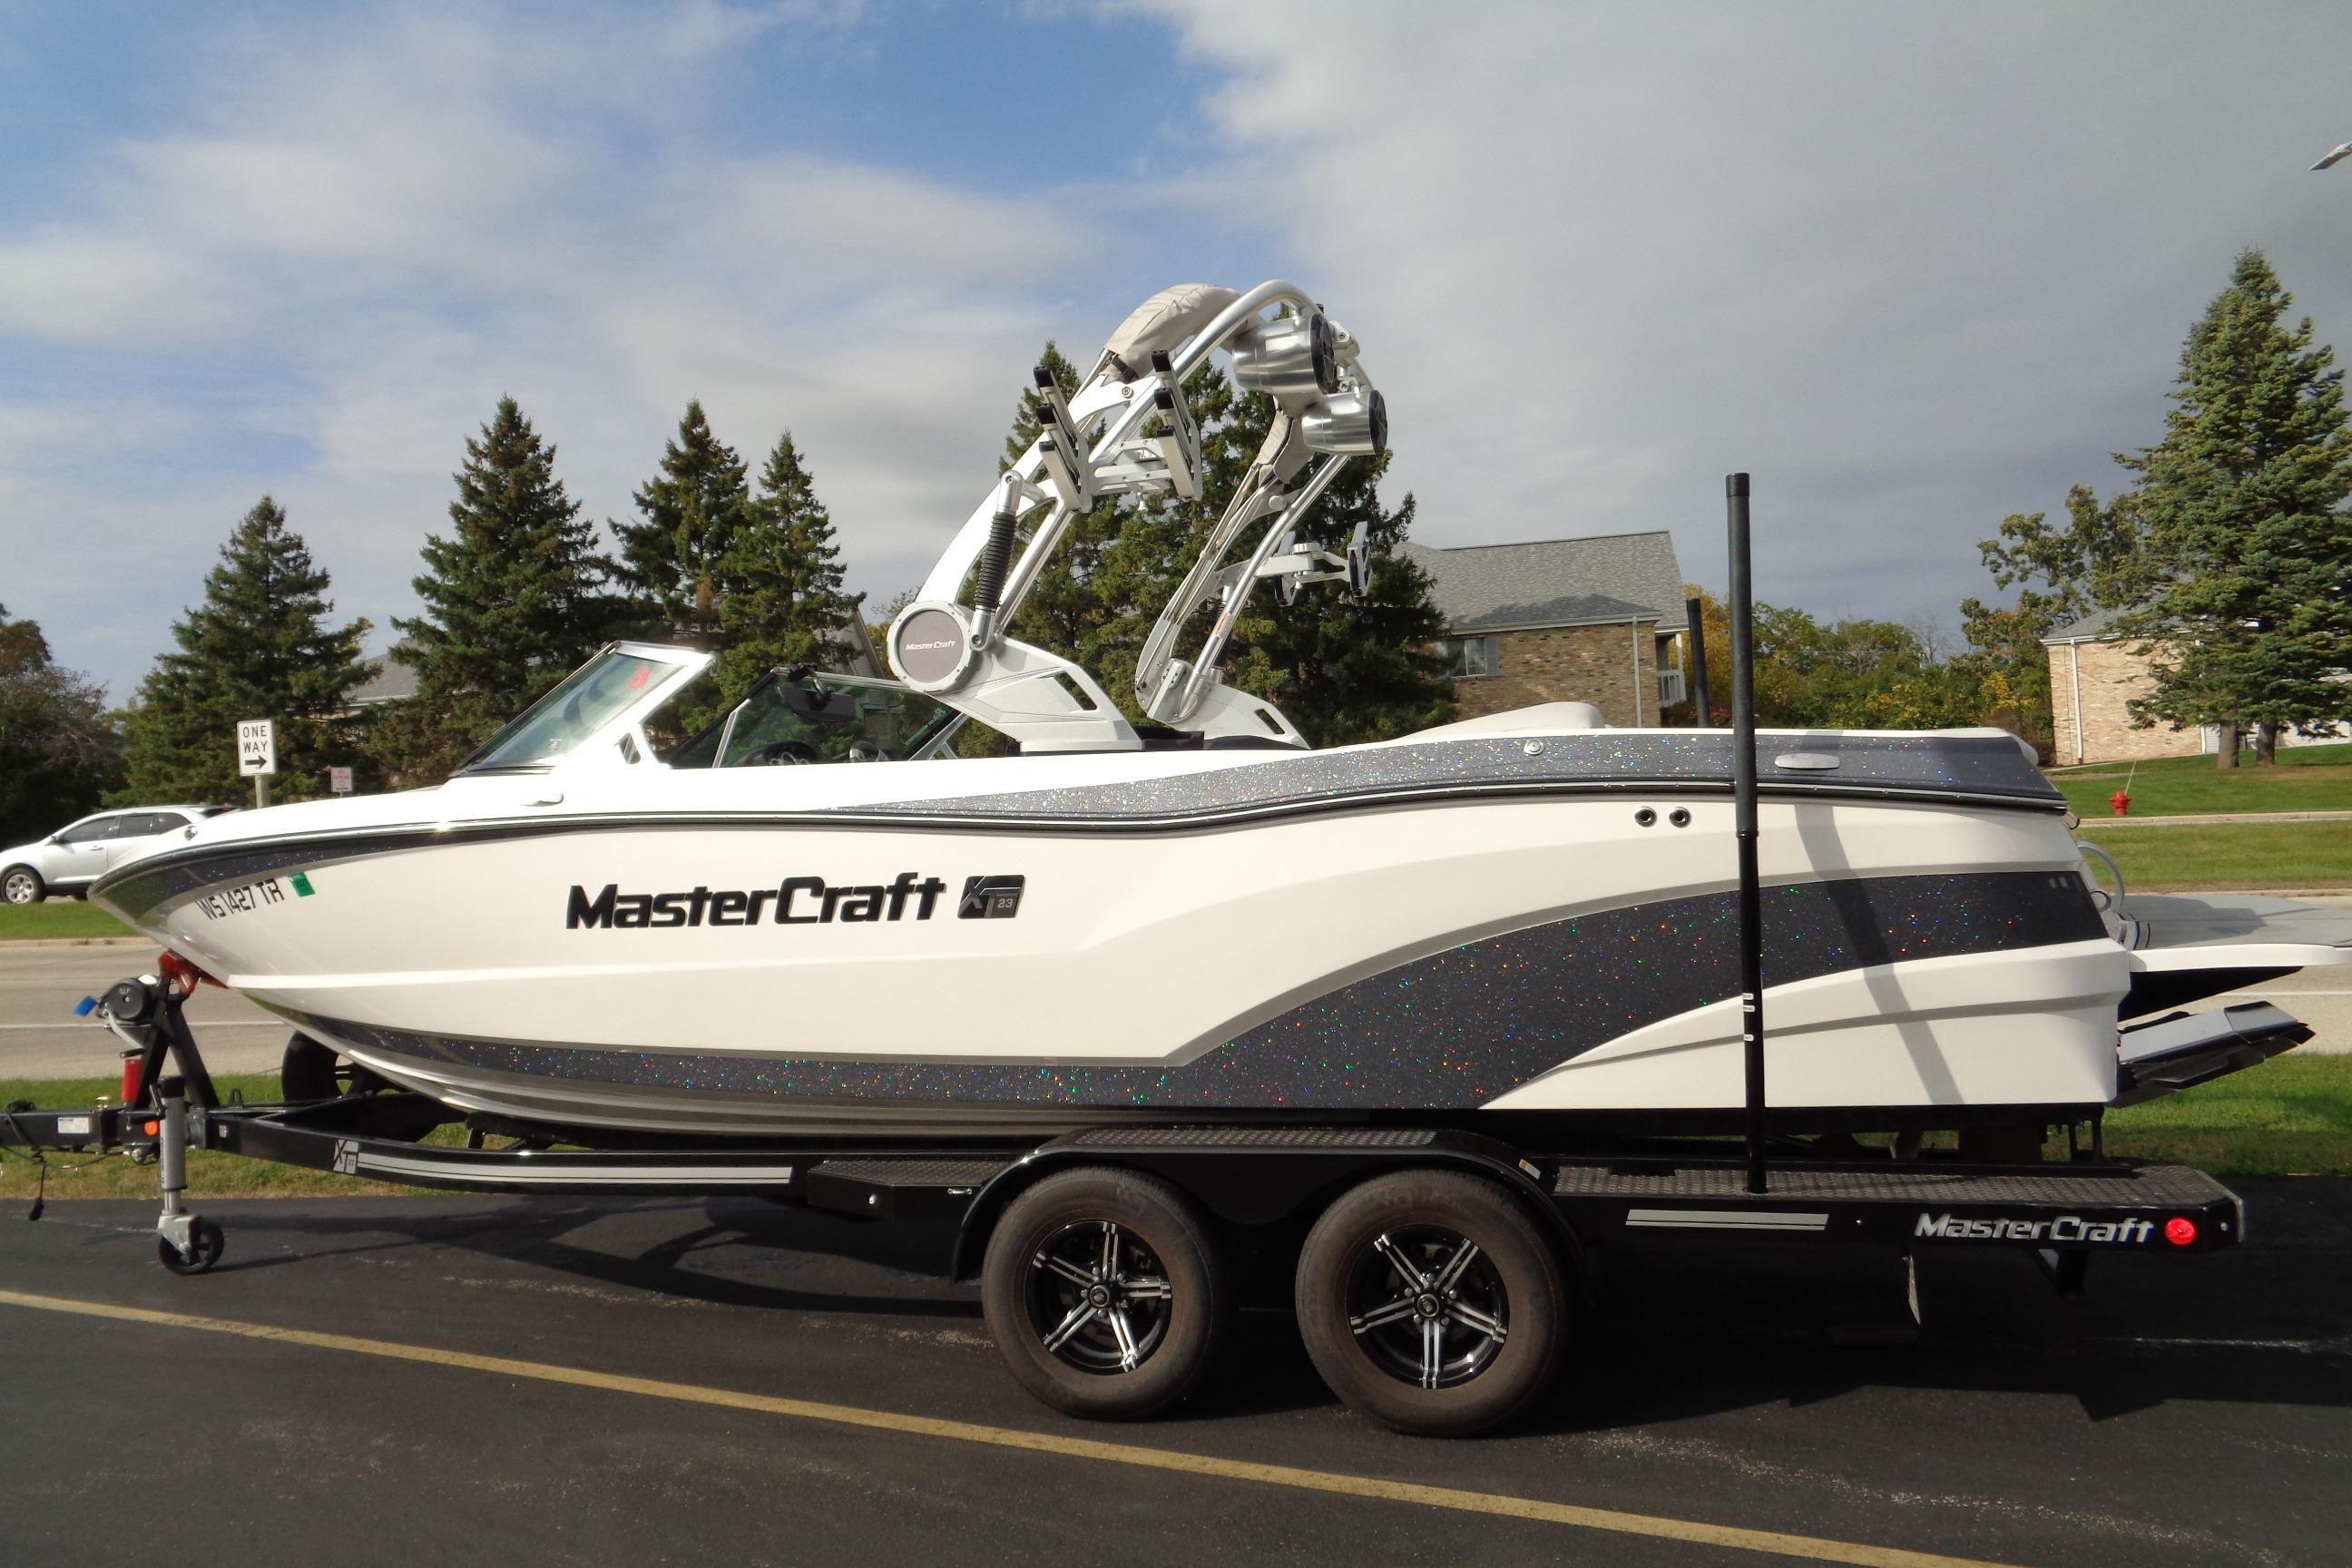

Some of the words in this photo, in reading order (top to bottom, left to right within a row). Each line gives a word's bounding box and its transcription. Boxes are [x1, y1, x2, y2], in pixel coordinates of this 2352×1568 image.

[906, 640, 956, 651] MasterCraft
[242, 725, 267, 739] ONE
[243, 740, 268, 753] WAY
[195, 895, 227, 921] WS
[219, 885, 256, 916] 1427
[255, 877, 285, 905] TR
[566, 872, 946, 929] MasterCraft
[997, 897, 1014, 908] 23
[1915, 1212, 2154, 1242] MasterCraft
